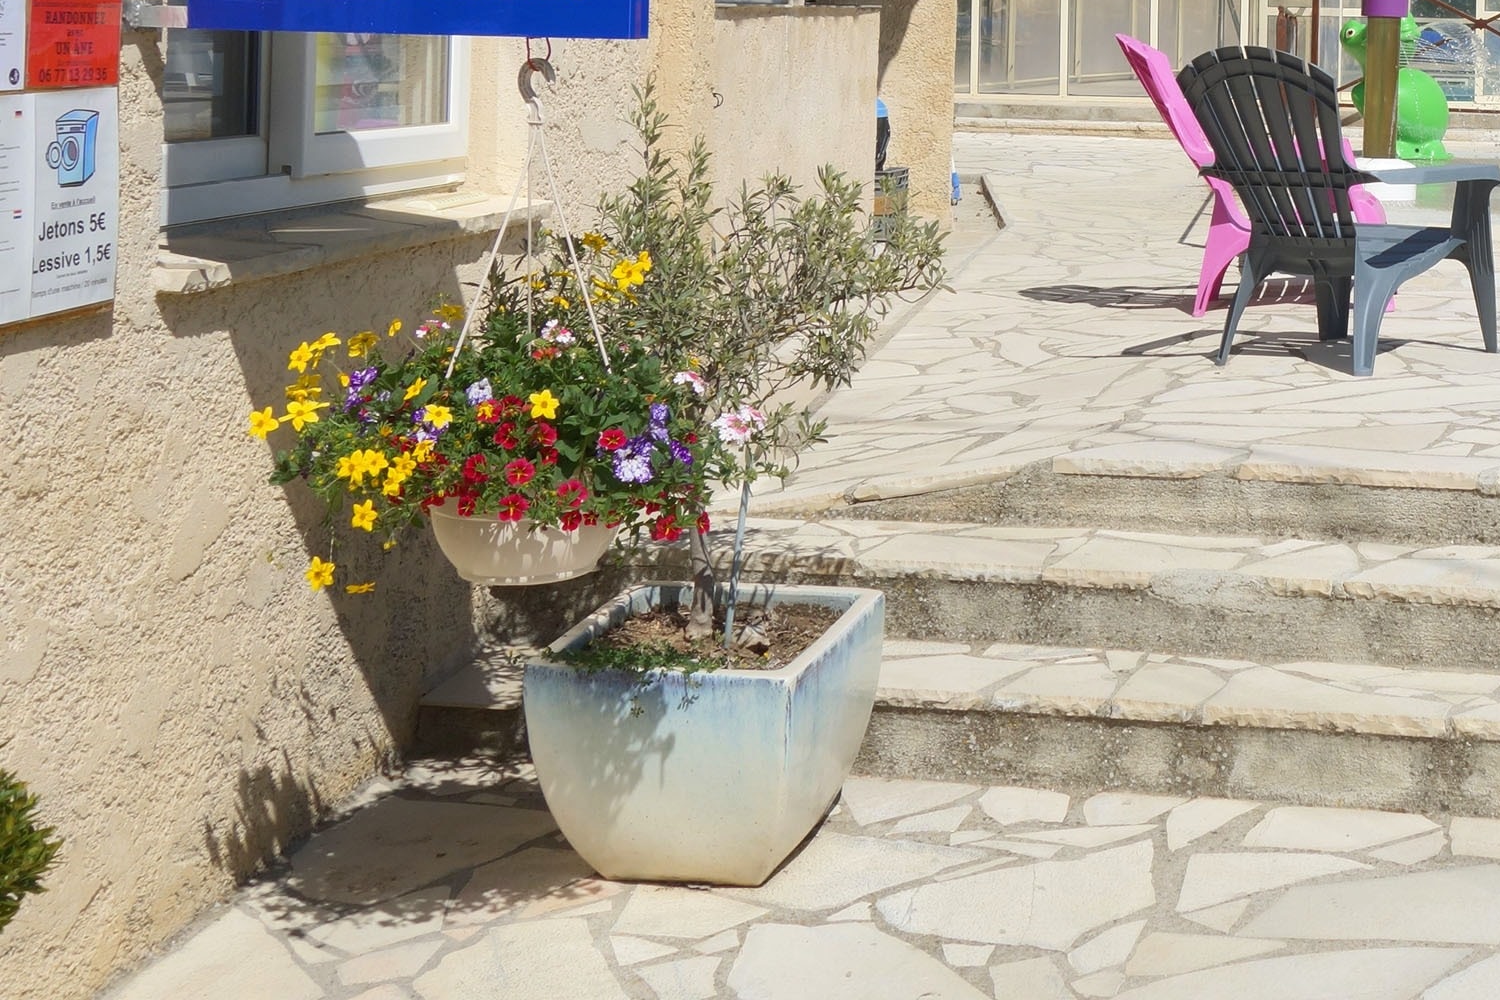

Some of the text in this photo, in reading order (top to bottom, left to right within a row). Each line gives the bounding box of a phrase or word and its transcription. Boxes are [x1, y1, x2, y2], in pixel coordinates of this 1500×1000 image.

[54, 68, 65, 82] 77
[38, 212, 106, 242] Jetons 5€
[32, 243, 112, 275] Lessive 1,5€
